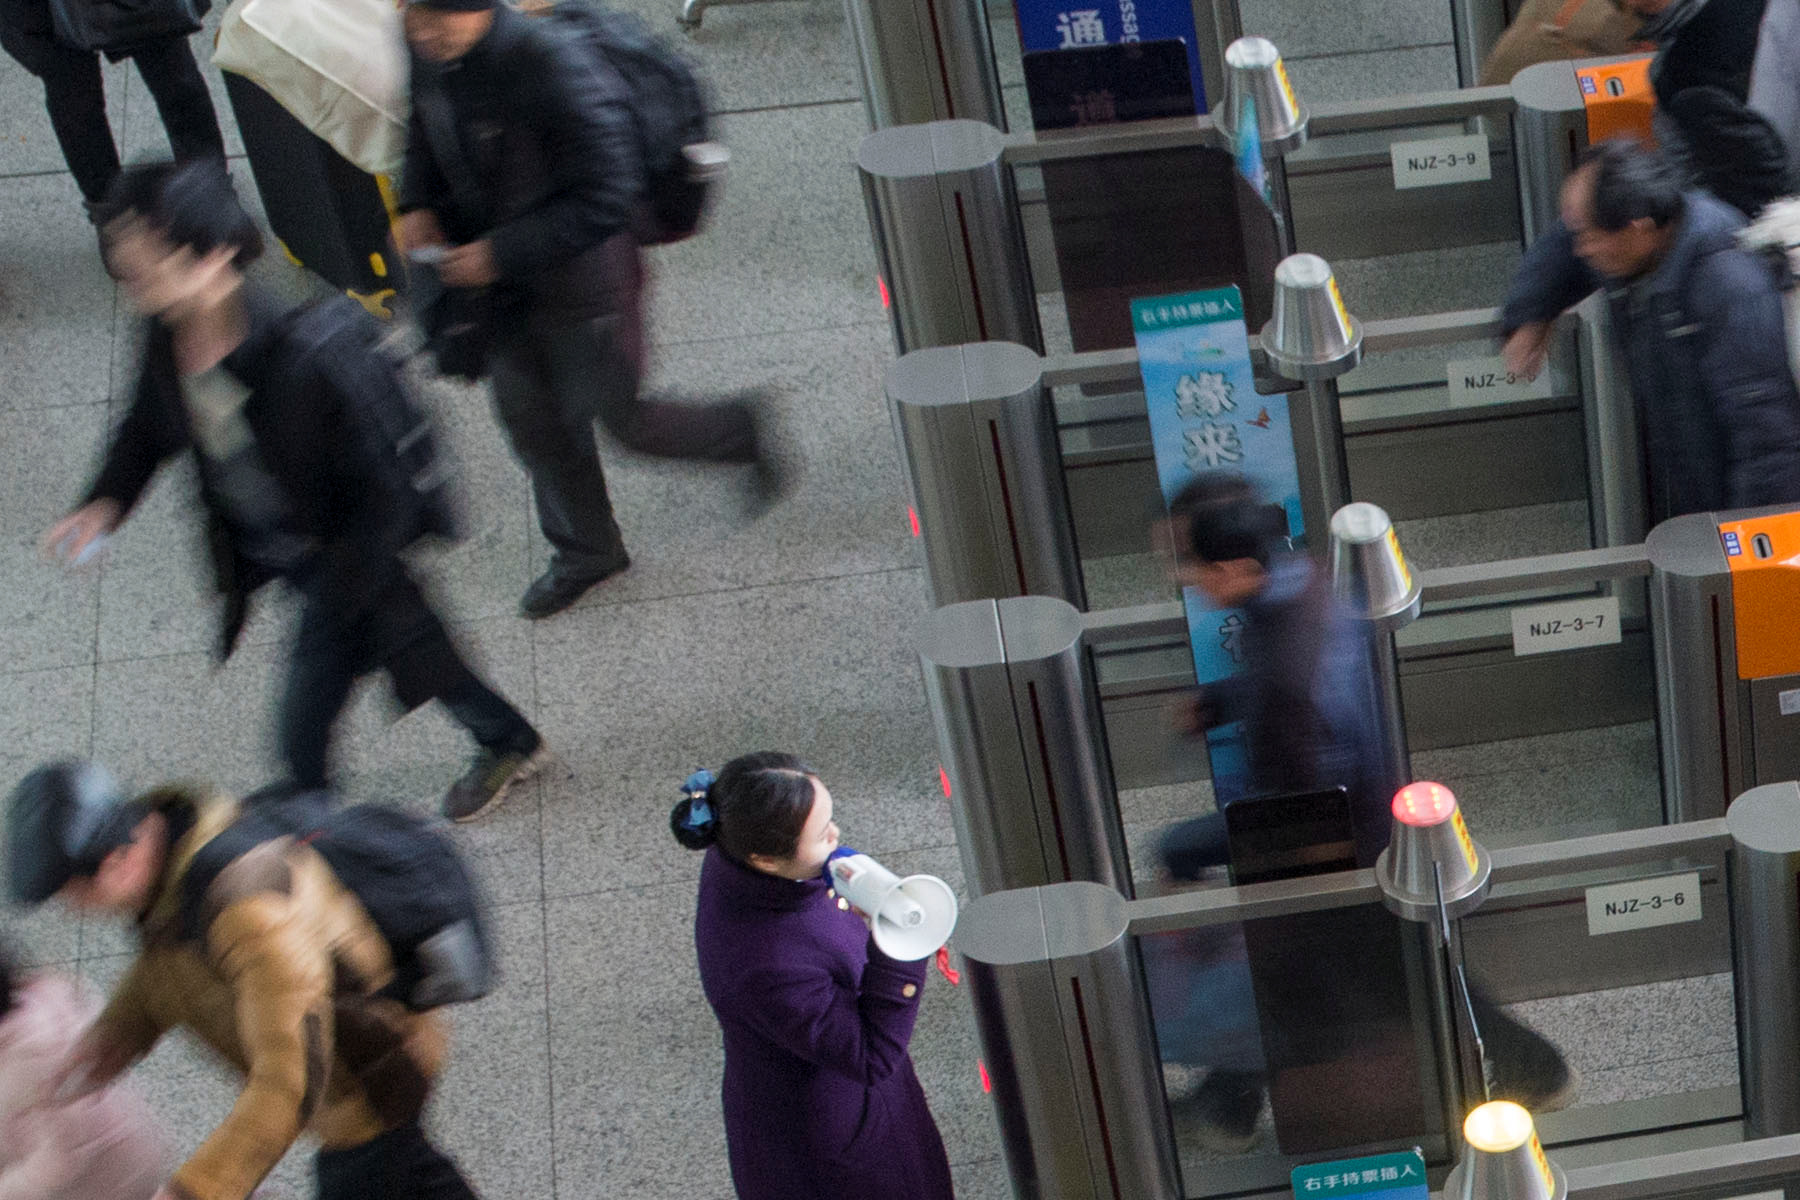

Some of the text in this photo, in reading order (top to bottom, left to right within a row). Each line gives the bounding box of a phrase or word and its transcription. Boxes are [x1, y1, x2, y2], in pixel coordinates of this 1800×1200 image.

[1056, 8, 1108, 49] 通
[1408, 152, 1476, 171] NJZ-3-9
[1530, 614, 1605, 637] NJZ-3-7
[1605, 892, 1685, 916] NJZ-3-6
[1303, 1164, 1418, 1191] 右手持票插入
